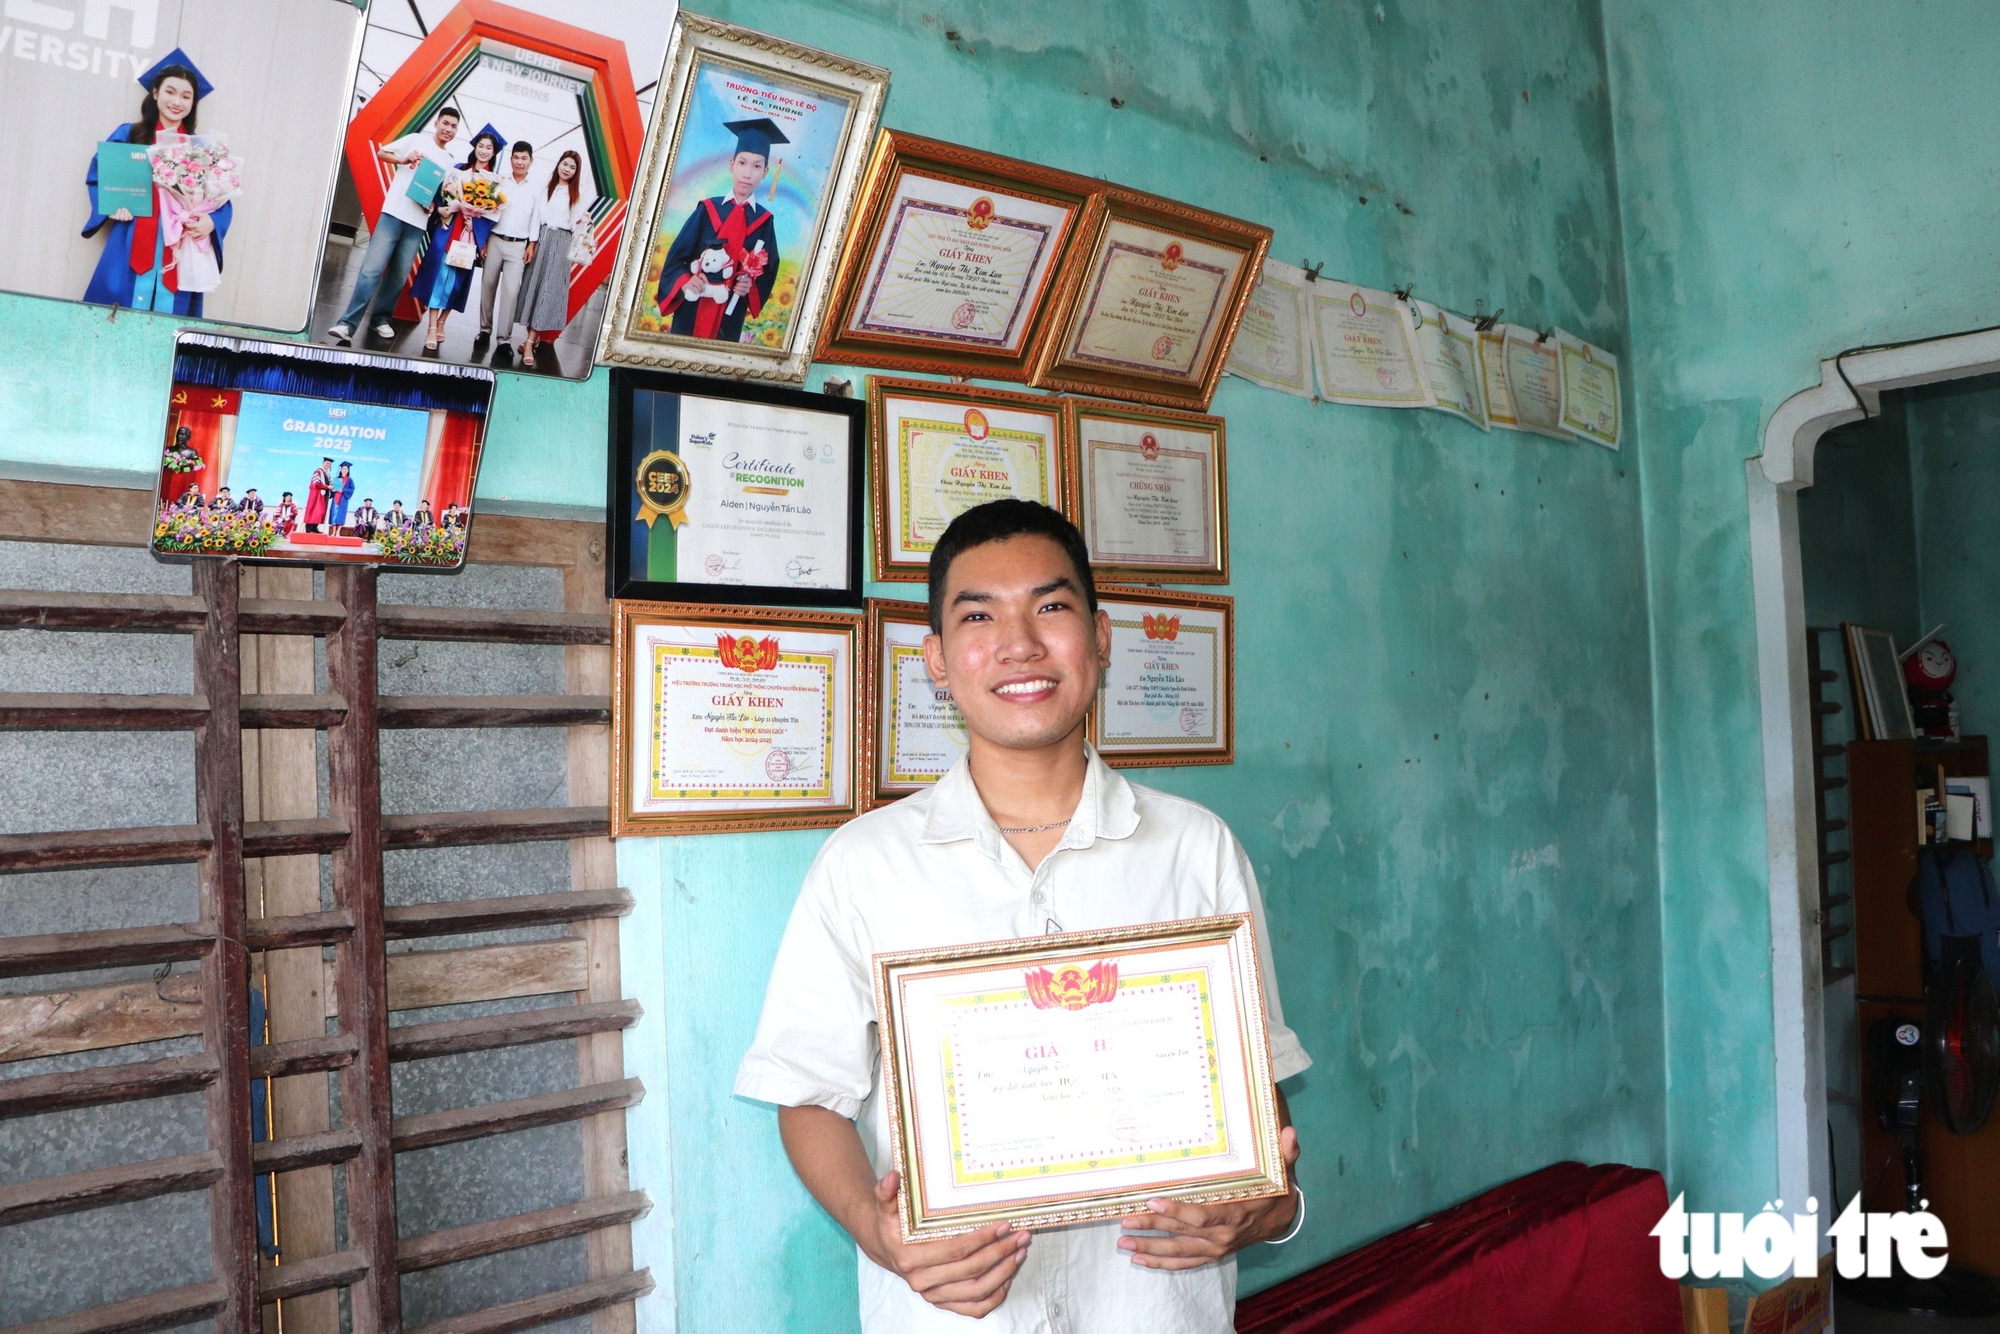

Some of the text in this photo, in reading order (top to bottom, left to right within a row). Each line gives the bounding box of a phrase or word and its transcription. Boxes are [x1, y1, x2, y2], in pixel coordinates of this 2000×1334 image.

[515, 48, 562, 72] UEHER
[480, 57, 586, 96] A NEW JOURNEY
[504, 82, 550, 104] BEGINS
[939, 246, 993, 264] GIẤY KHEN
[929, 260, 956, 271] Nguyễn
[972, 266, 987, 276] Kim
[988, 270, 1002, 278] Lan
[1139, 286, 1158, 298] GIẤY
[1160, 292, 1182, 304] KHEN
[1363, 336, 1382, 345] KHEN
[328, 408, 347, 417] UEH
[283, 418, 386, 440] GRADUATION
[313, 437, 352, 452] 2025
[722, 452, 797, 474] Certificate
[648, 471, 679, 483] CEEP
[736, 472, 804, 488] RECOGNITION
[950, 465, 1009, 481] GIẤY KHEN
[649, 482, 679, 493] 2024
[1130, 480, 1171, 494] CHỨNG NHẬN
[721, 500, 744, 509] Aiden
[749, 502, 780, 513] Nguyễn
[781, 504, 795, 513] Tấn
[1144, 660, 1160, 670] GIẤY
[1147, 674, 1164, 683] Nguyễn
[712, 692, 784, 708] GIẤY KHEN
